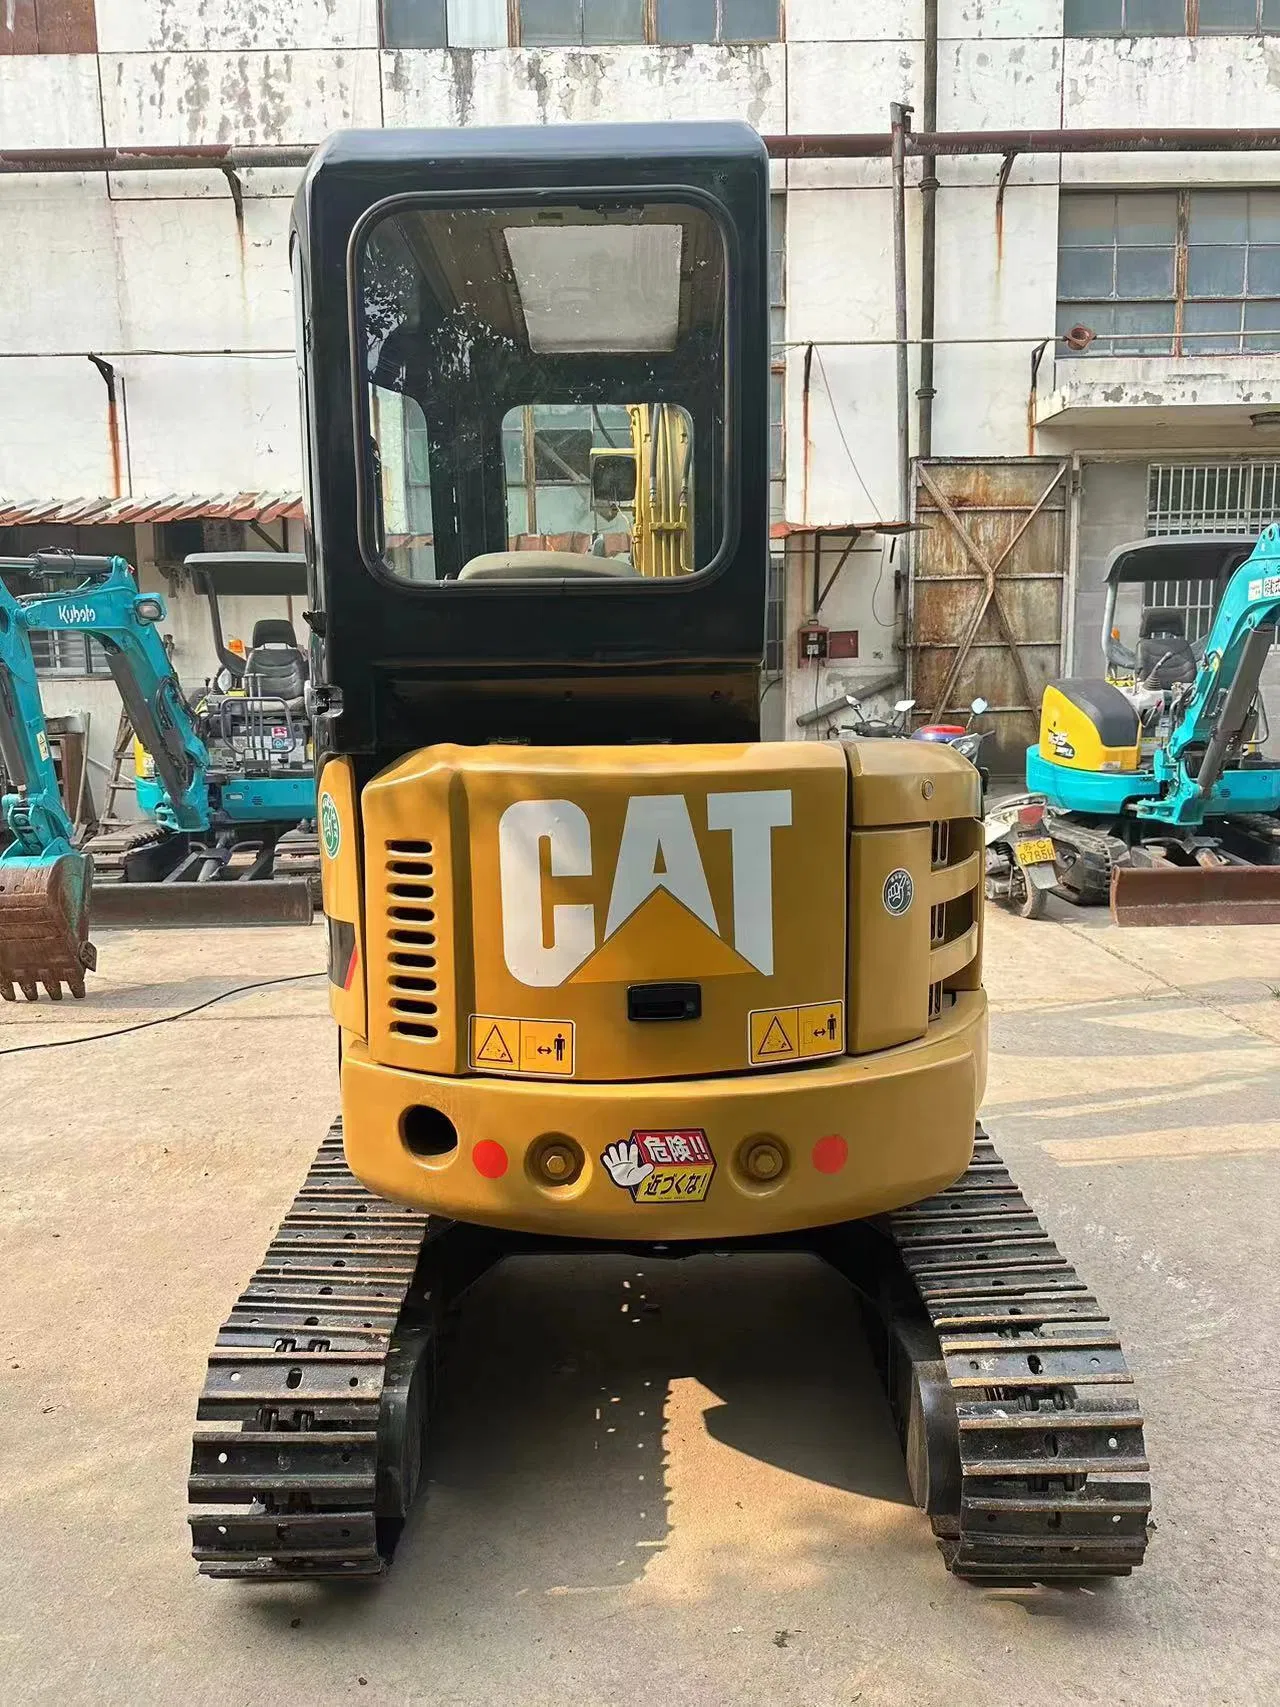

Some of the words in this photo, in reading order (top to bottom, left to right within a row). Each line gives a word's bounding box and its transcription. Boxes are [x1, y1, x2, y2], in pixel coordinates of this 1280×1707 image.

[58, 604, 96, 624] Kubota
[1019, 848, 1054, 864] R785H
[499, 789, 792, 988] CAT
[643, 1173, 708, 1196] 近づくな!
